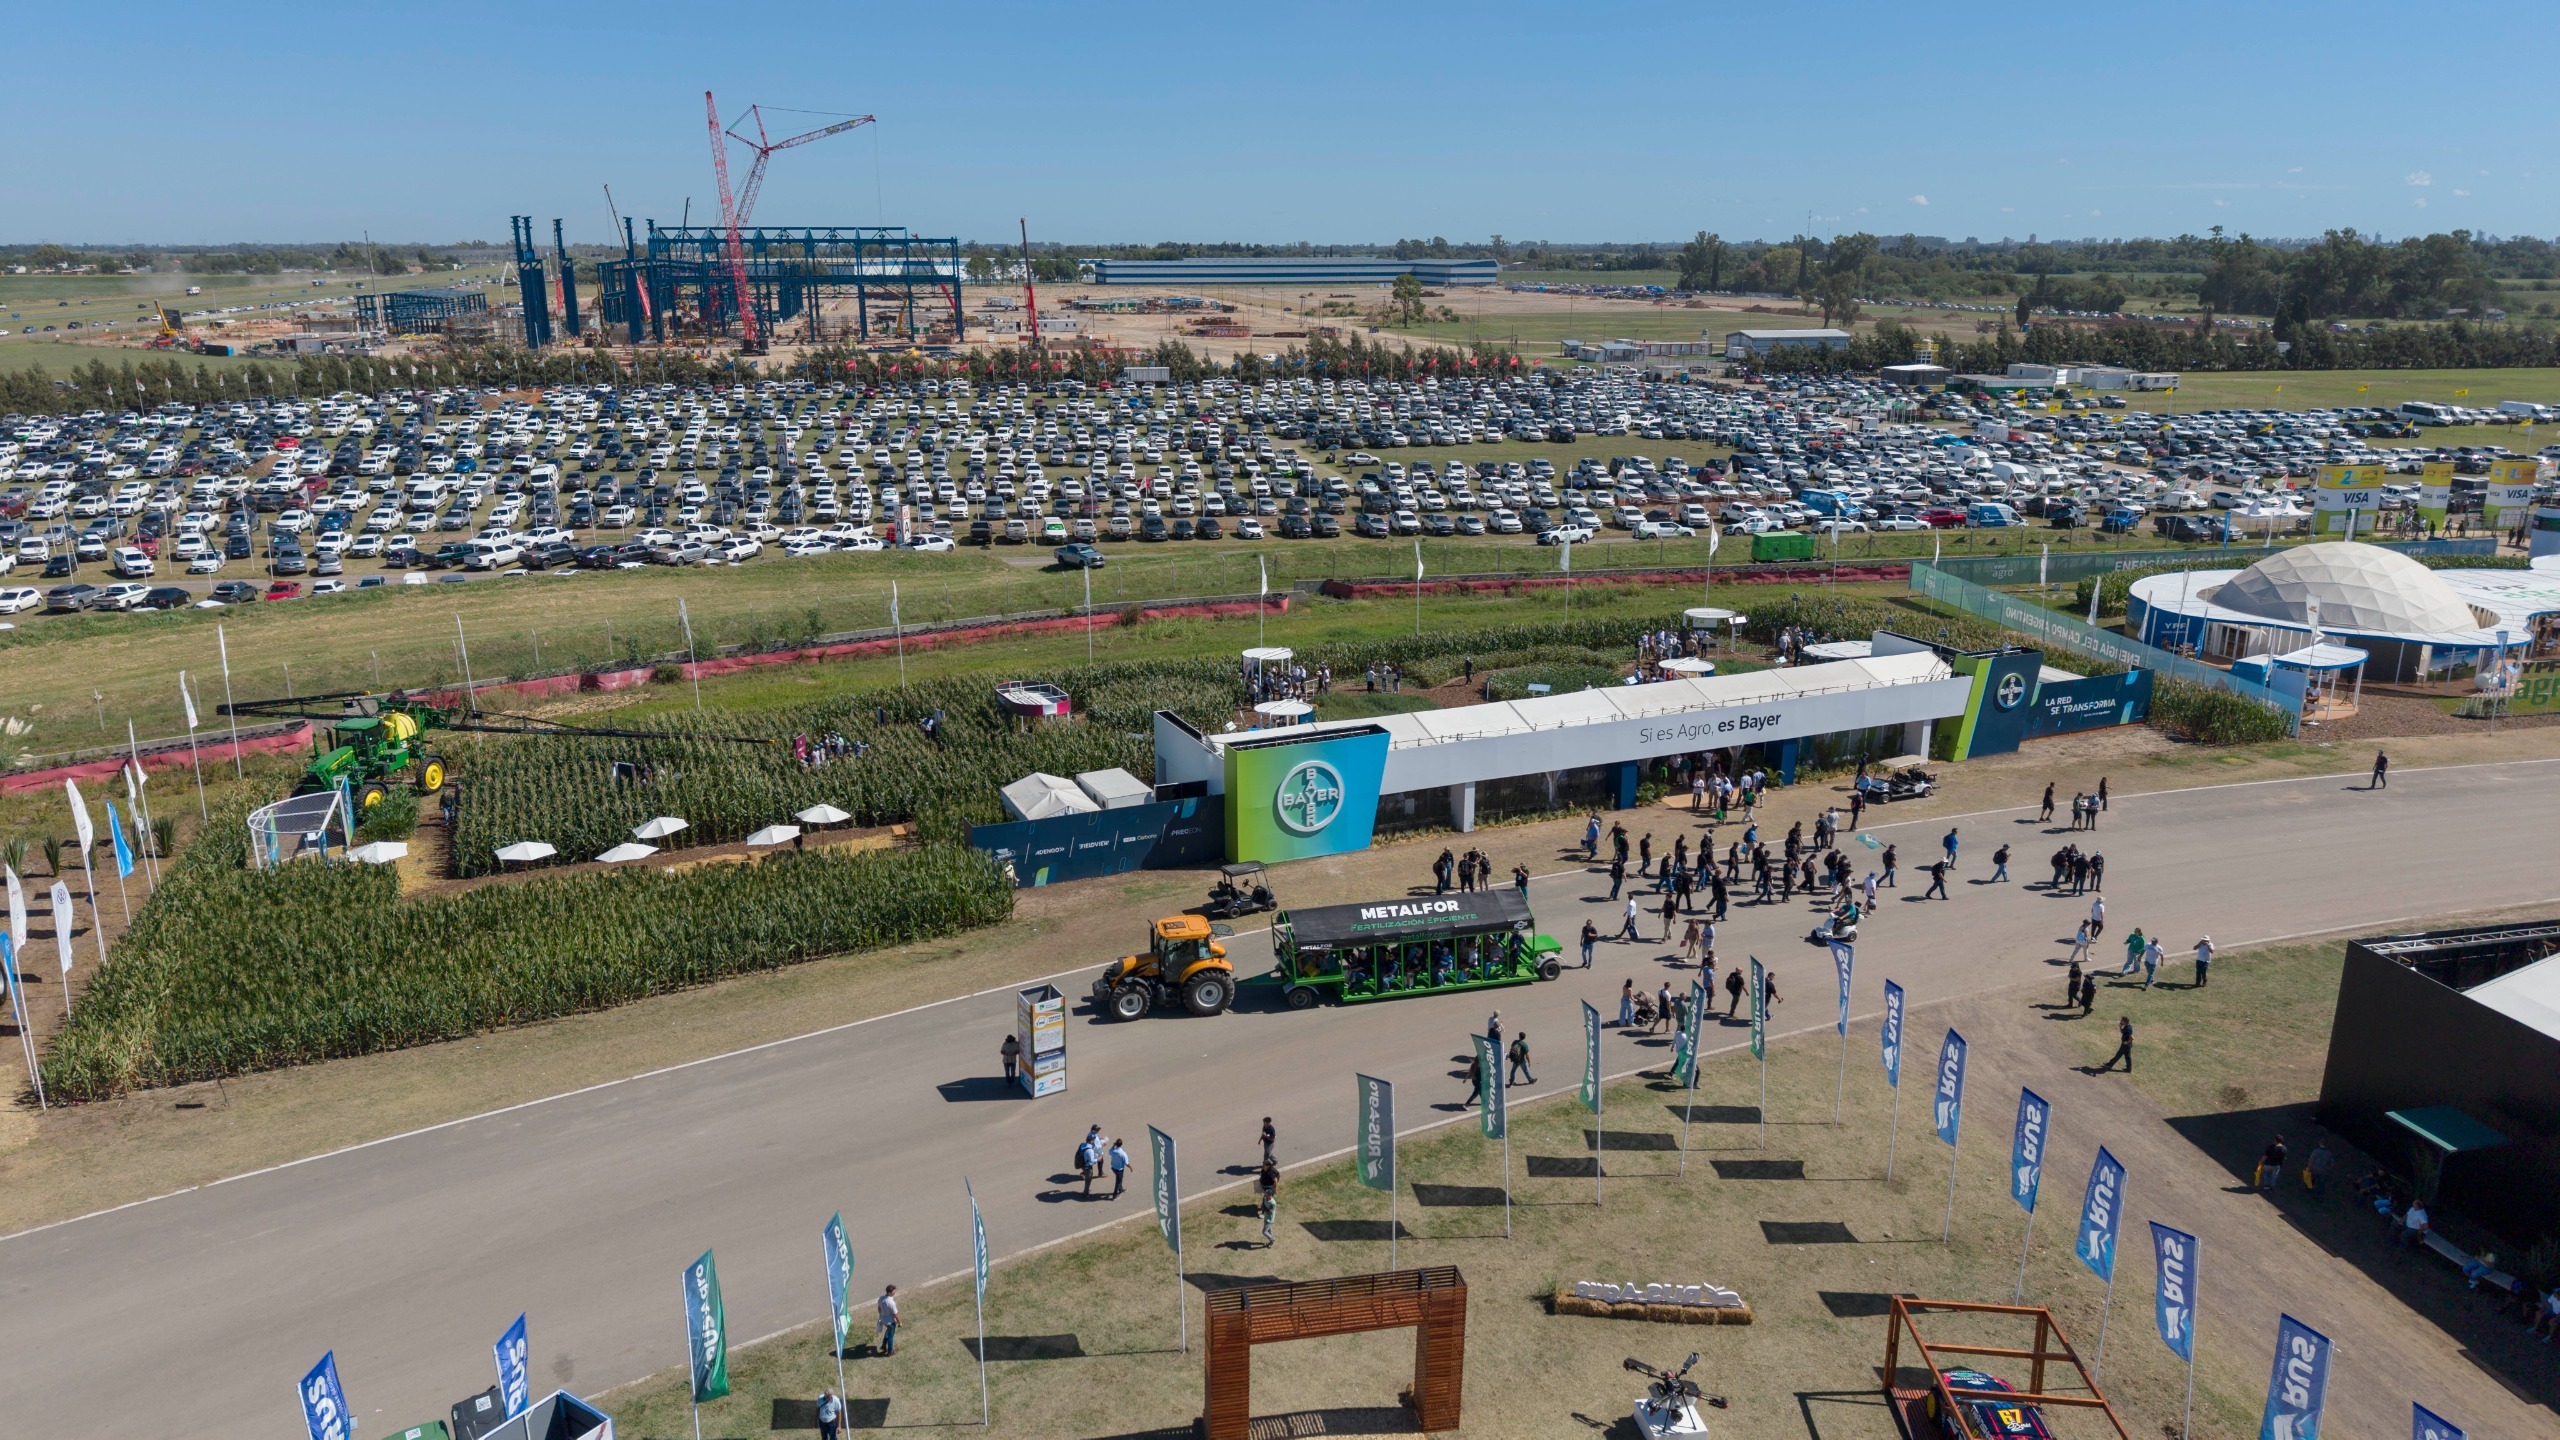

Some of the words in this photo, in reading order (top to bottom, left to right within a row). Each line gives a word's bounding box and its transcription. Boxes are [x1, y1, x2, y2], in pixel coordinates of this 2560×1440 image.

[778, 446, 785, 456] A
[2343, 492, 2369, 504] VISA
[2507, 490, 2528, 498] VISA
[896, 520, 902, 534] A
[904, 521, 910, 534] A
[2406, 547, 2427, 556] YPF
[1992, 569, 2014, 580] agro
[2000, 686, 2023, 696] BAYER
[2008, 676, 2016, 706] BAYER
[2045, 698, 2056, 707] LA
[2057, 696, 2072, 706] RED
[2050, 706, 2060, 716] SE
[2063, 698, 2116, 714] TRANSFORMA
[1640, 728, 1652, 744] Si
[1656, 728, 1673, 741] es
[1676, 722, 1714, 740] Agro,
[1718, 720, 1734, 732] es
[1739, 712, 1782, 732] Bayer
[1284, 788, 1339, 807] BAYER
[1305, 768, 1318, 827] BAYER
[1136, 834, 1158, 842] Carbono
[1079, 840, 1110, 850] FIELDVIEW
[1360, 900, 1460, 920] METALFOR
[1350, 918, 1424, 932] FERTILIZACIÓN
[1427, 913, 1478, 924] EFICIENTE
[1400, 930, 1450, 942] metalfor.com
[1300, 942, 1333, 950] METALFOR
[508, 1337, 525, 1417] RUS
[1998, 1408, 2022, 1425] 67
